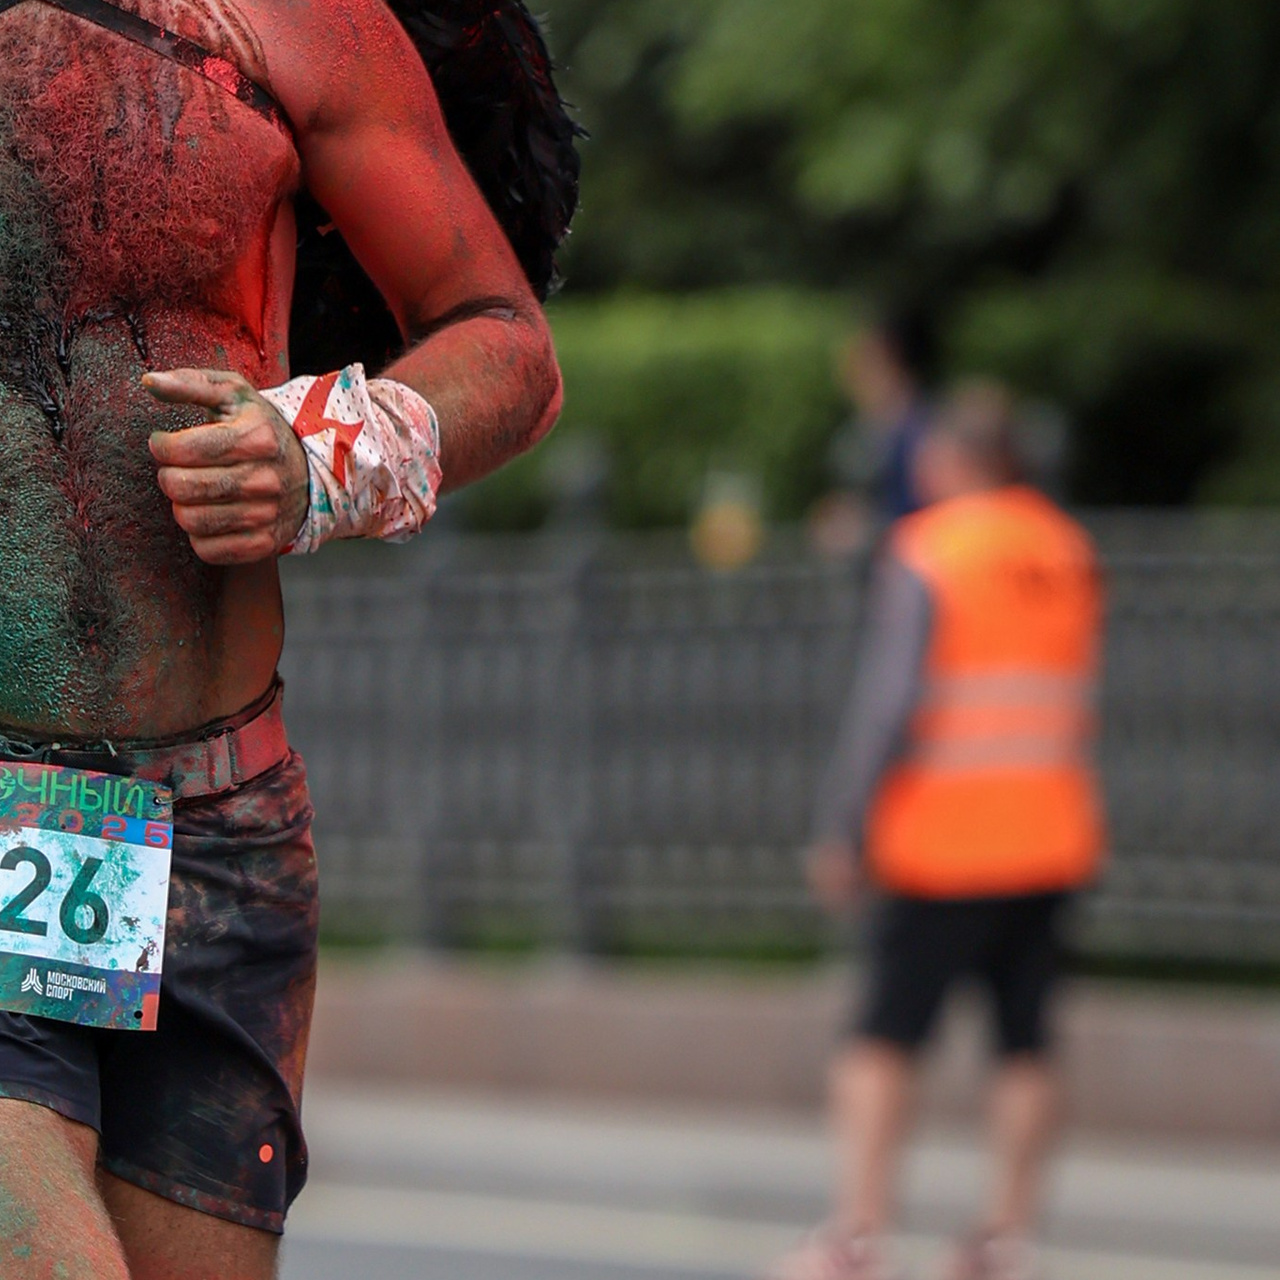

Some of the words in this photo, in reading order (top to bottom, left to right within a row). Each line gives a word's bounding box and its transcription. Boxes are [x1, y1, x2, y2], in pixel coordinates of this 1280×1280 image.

[15, 802, 170, 849] 2025
[45, 983, 75, 1002] СПОРТ
[46, 970, 107, 995] МОСКОВСКИЙ
